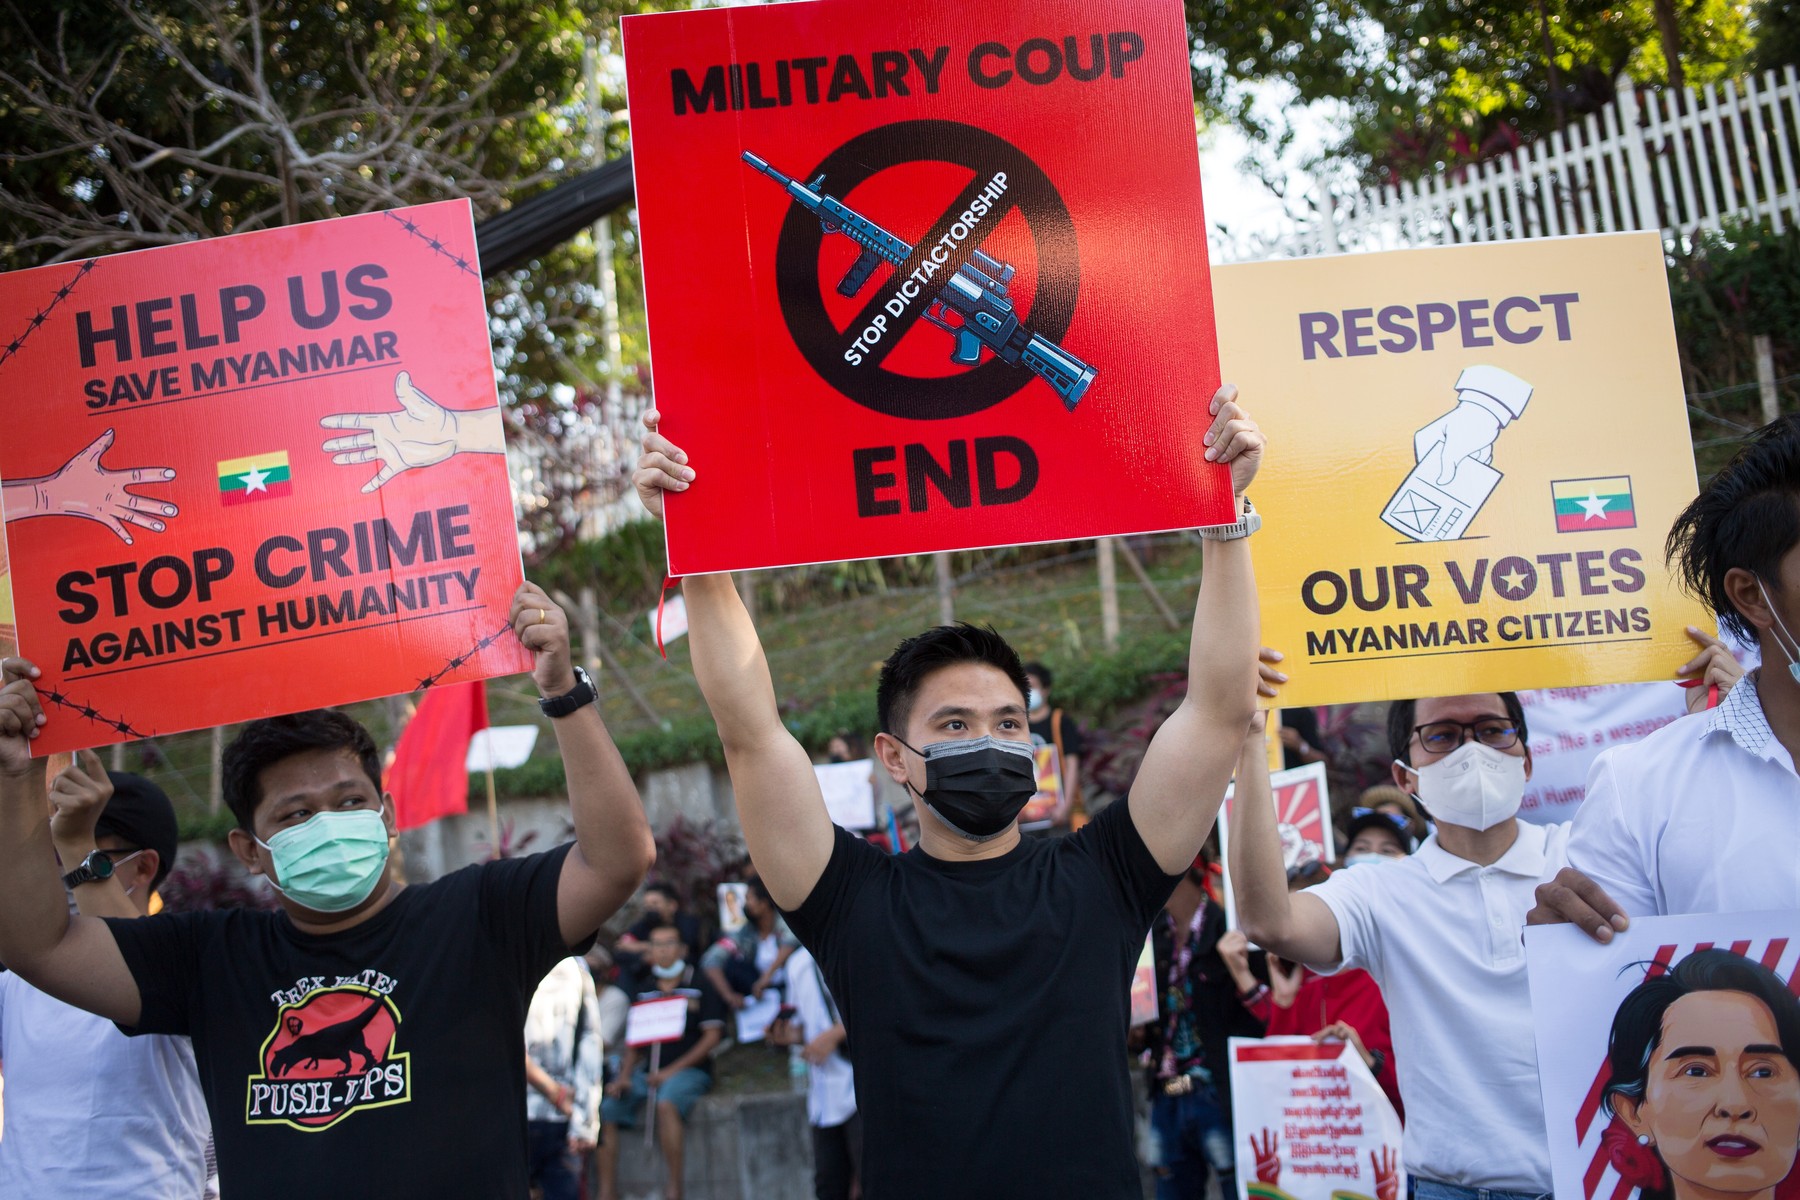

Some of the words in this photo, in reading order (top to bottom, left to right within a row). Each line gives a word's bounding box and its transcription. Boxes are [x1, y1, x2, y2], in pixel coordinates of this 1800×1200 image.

[671, 46, 950, 116] MILITARY
[967, 31, 1145, 90] COUP
[843, 314, 888, 366] STOP
[884, 171, 1009, 319] DICTACTORSHIP
[75, 284, 266, 368] HELP
[288, 263, 393, 330] US
[1298, 292, 1580, 361] RESPECT
[83, 365, 182, 410] SAVE
[190, 331, 399, 394] MYANMAR
[852, 436, 1040, 519] END
[55, 547, 235, 625] STOP
[254, 504, 476, 590] CRIME
[1301, 564, 1430, 616] OUR
[1444, 548, 1646, 606] VOTES
[61, 608, 246, 673] AGAINST
[257, 567, 482, 638] HUMANITY
[1306, 616, 1490, 657] MYANMAR
[1496, 606, 1652, 642] CITIZENS
[1558, 729, 1588, 752] like
[1593, 730, 1605, 746] a
[250, 1063, 405, 1116] PUSH-UPS
